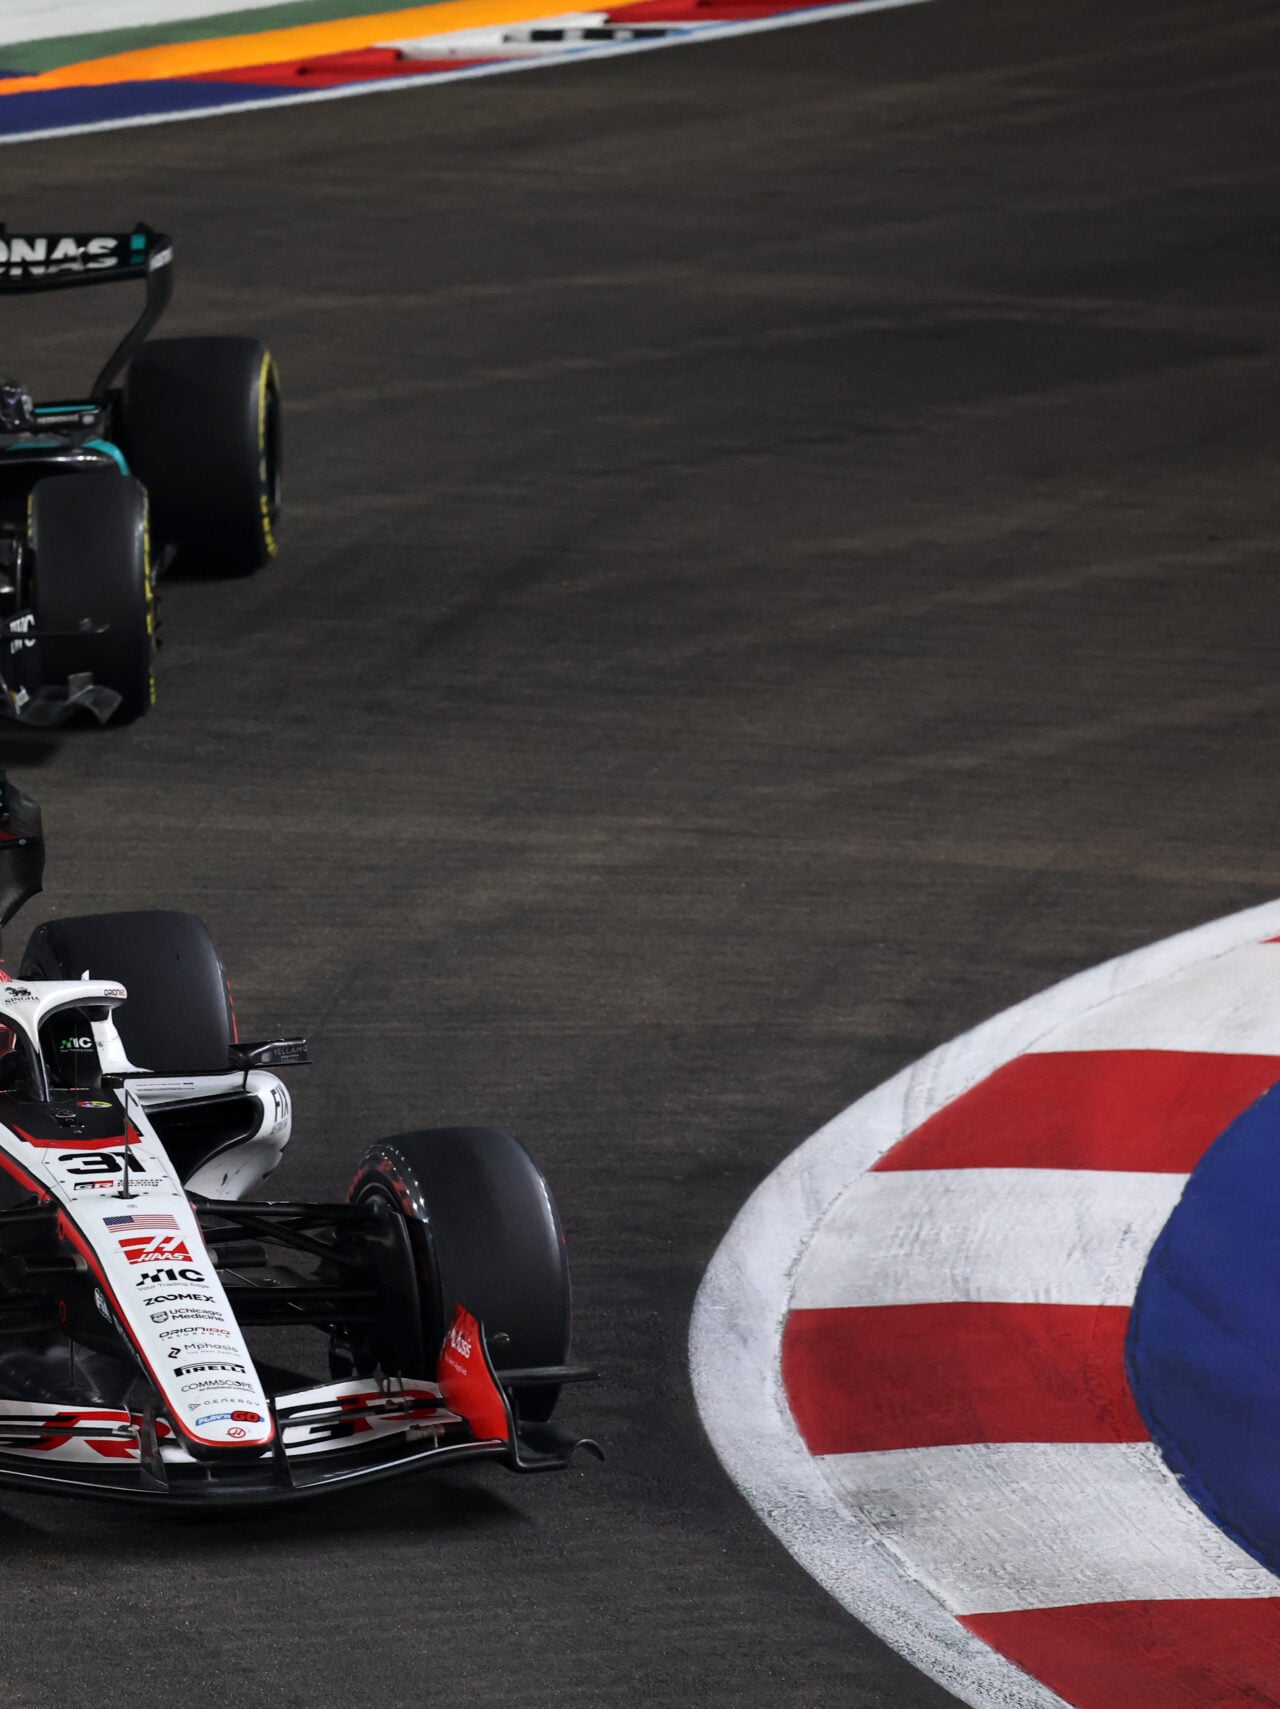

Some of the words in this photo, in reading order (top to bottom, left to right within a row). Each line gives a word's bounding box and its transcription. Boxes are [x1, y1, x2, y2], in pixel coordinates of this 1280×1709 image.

[58, 1151, 146, 1175] 31
[136, 1253, 186, 1263] HAAS
[143, 1293, 216, 1307] ZOOMEX
[169, 1308, 223, 1317] UChicago
[172, 1314, 225, 1322] Medicine
[184, 1343, 239, 1353] Mphasis
[173, 1361, 247, 1378] PIRELLI
[181, 1379, 254, 1392] COMMSCOPE
[232, 1411, 261, 1423] GO
